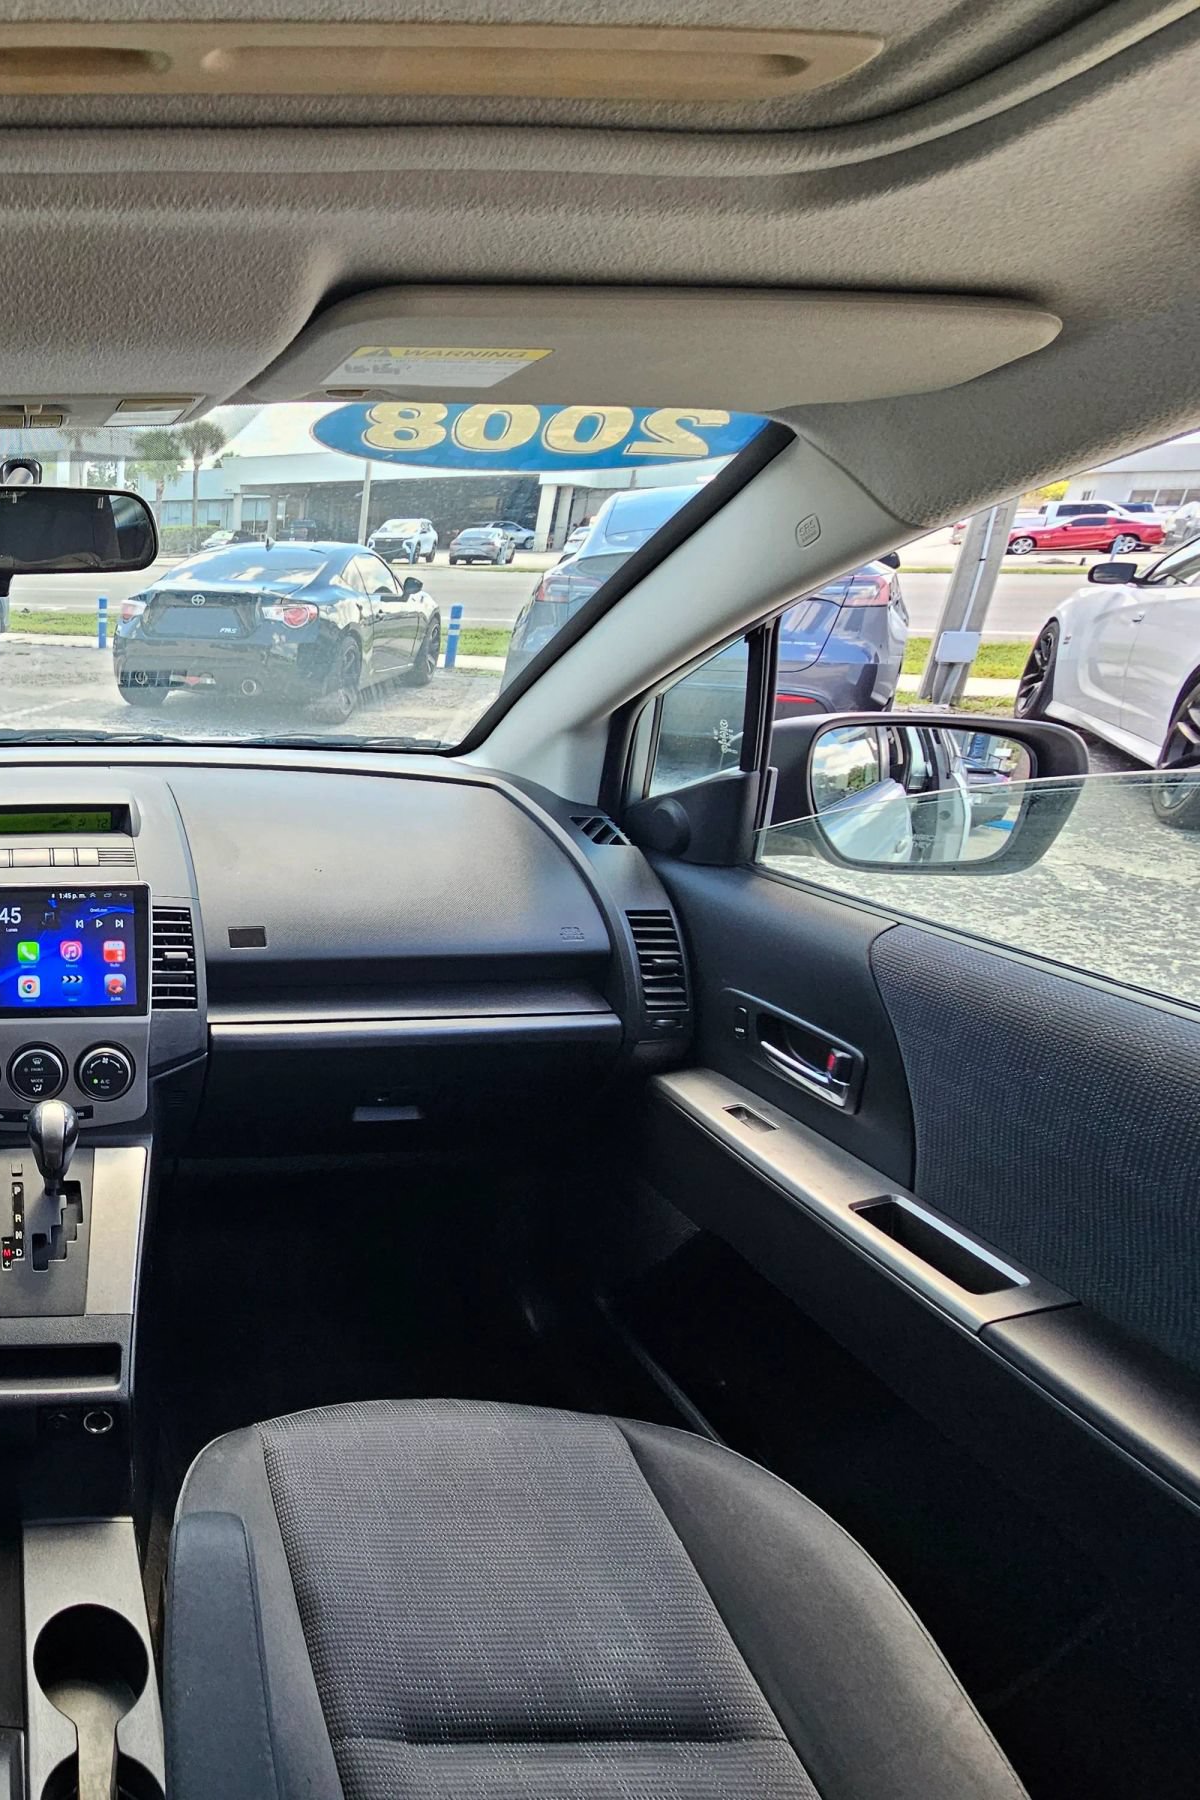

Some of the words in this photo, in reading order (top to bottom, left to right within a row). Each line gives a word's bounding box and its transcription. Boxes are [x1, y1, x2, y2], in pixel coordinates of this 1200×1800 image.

[403, 348, 527, 359] WARNING
[13, 1186, 21, 1195] P
[15, 1214, 22, 1223] R
[15, 1231, 22, 1239] N
